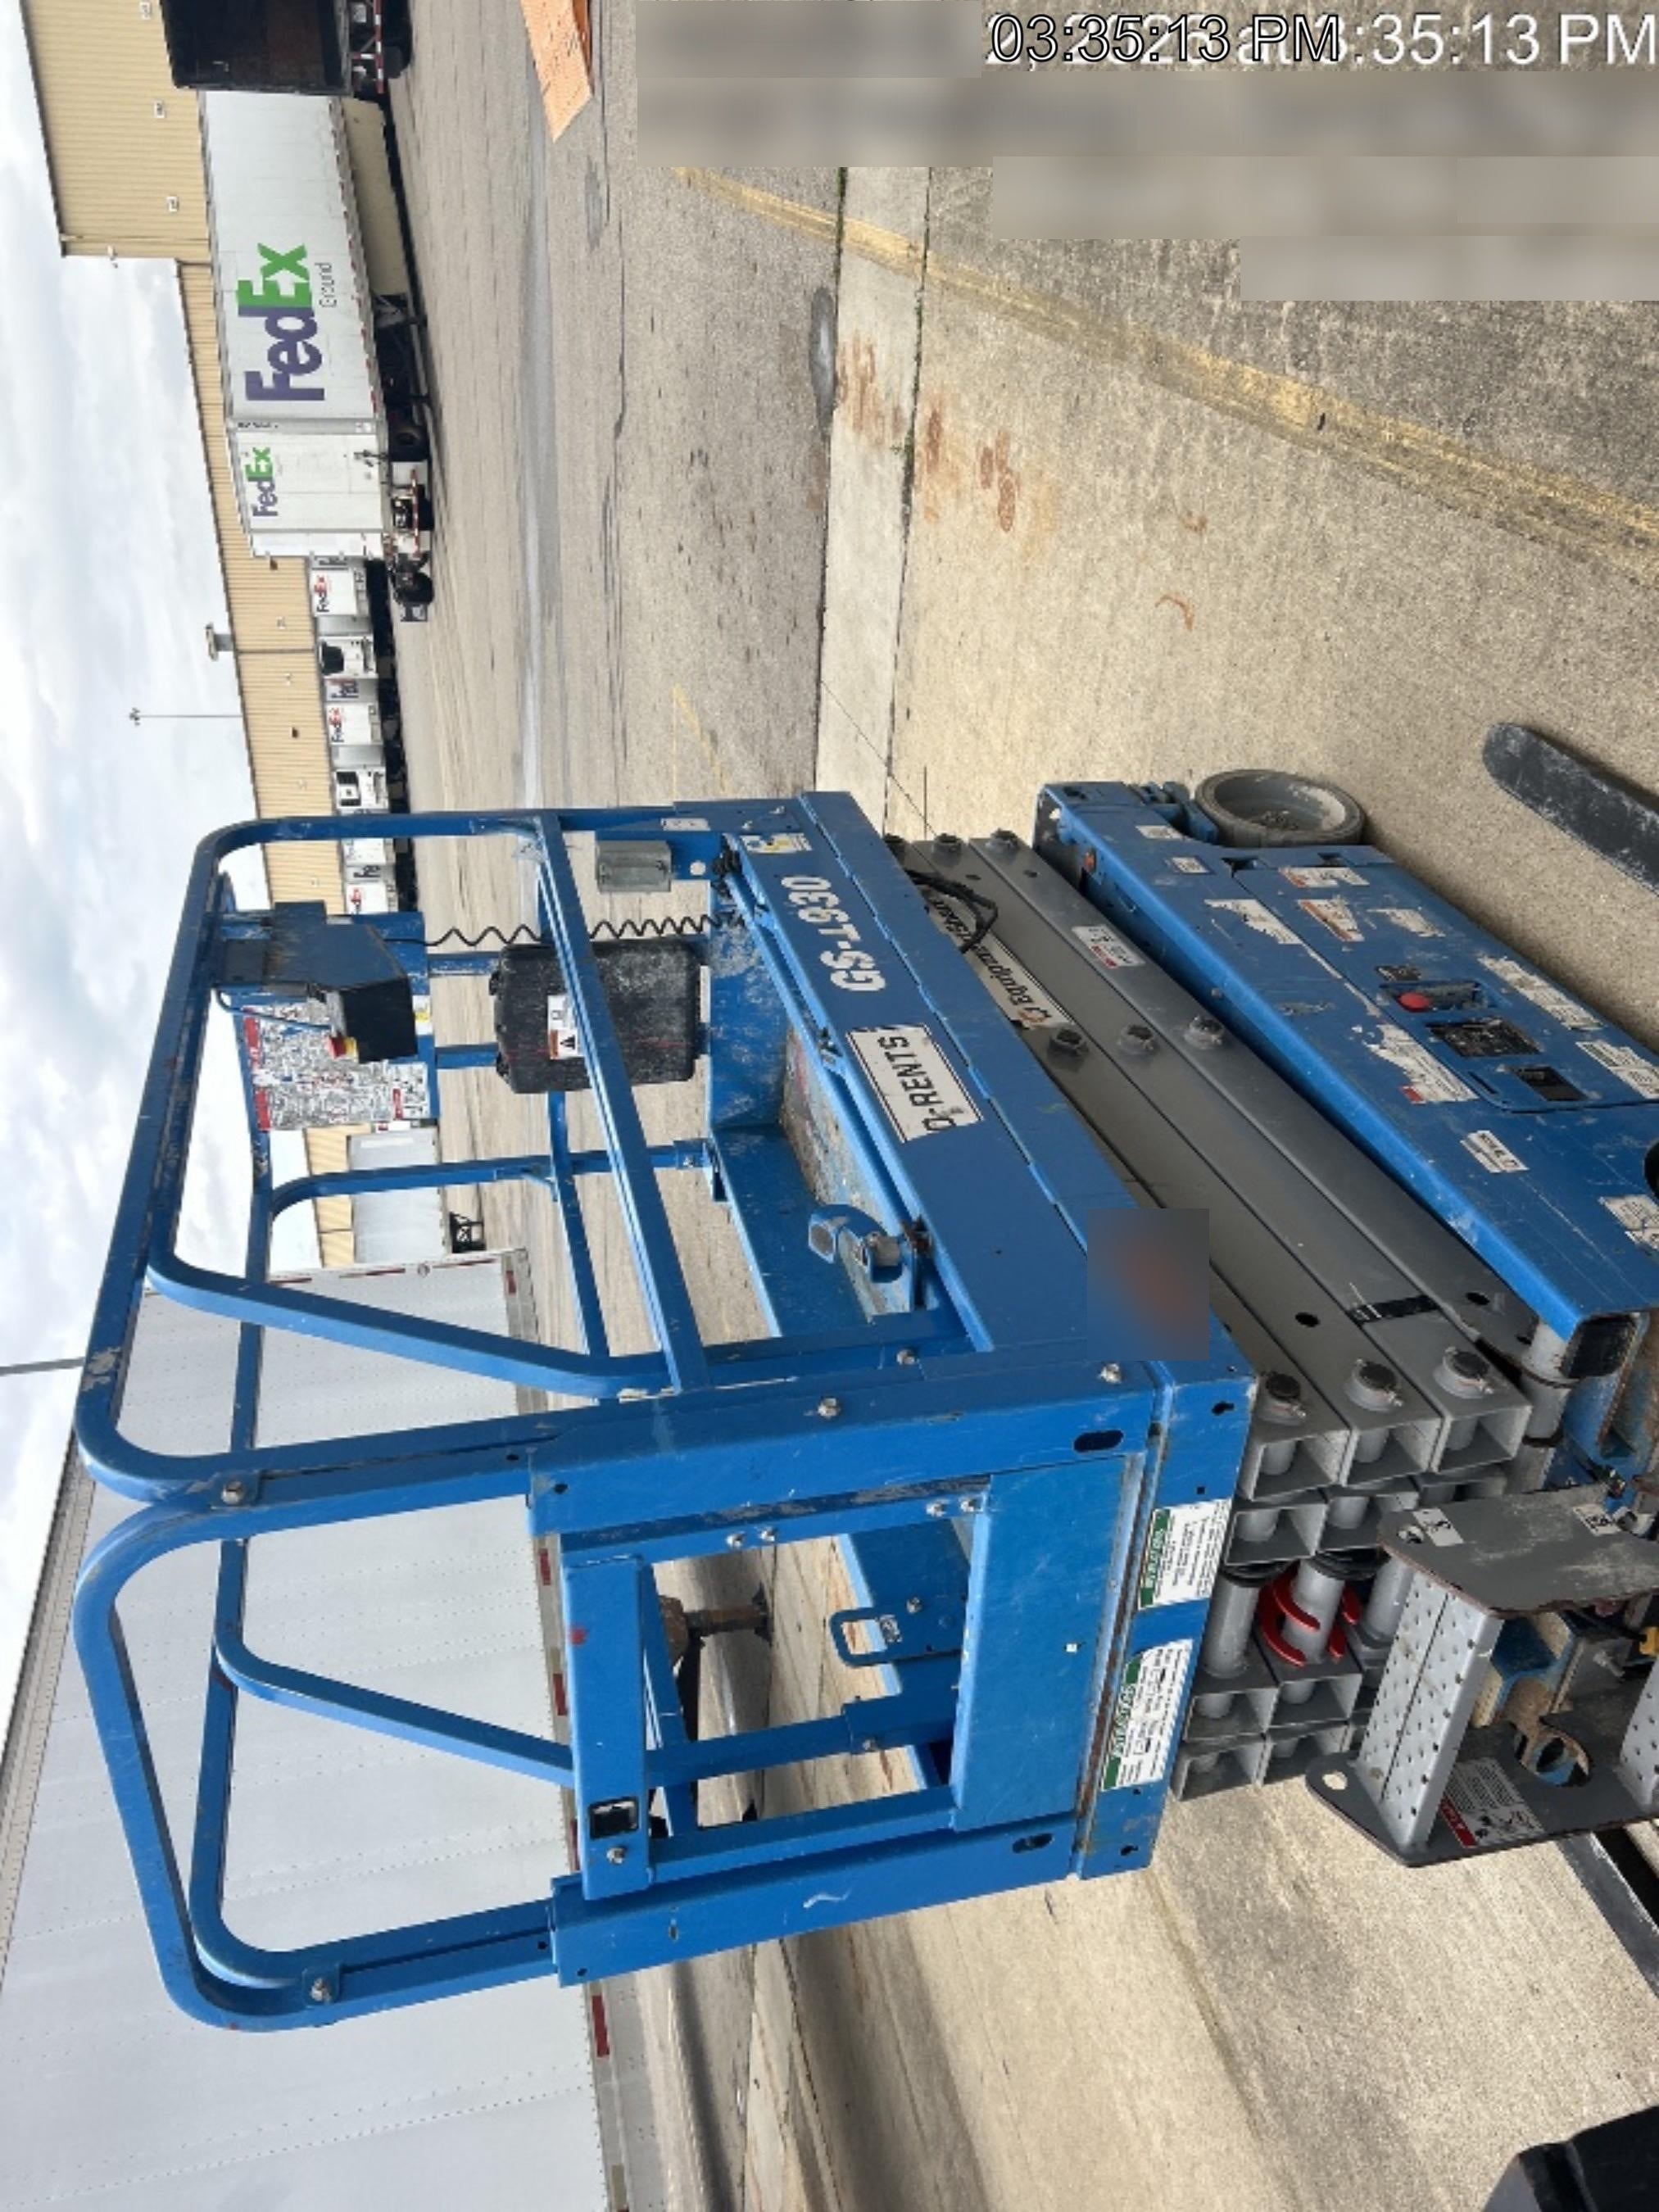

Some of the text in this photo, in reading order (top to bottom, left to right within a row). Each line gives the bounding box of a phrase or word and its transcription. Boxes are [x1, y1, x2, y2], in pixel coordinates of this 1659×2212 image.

[234, 243, 325, 401] FedEx
[244, 447, 279, 517] FedEx
[781, 876, 885, 991] GS-1930
